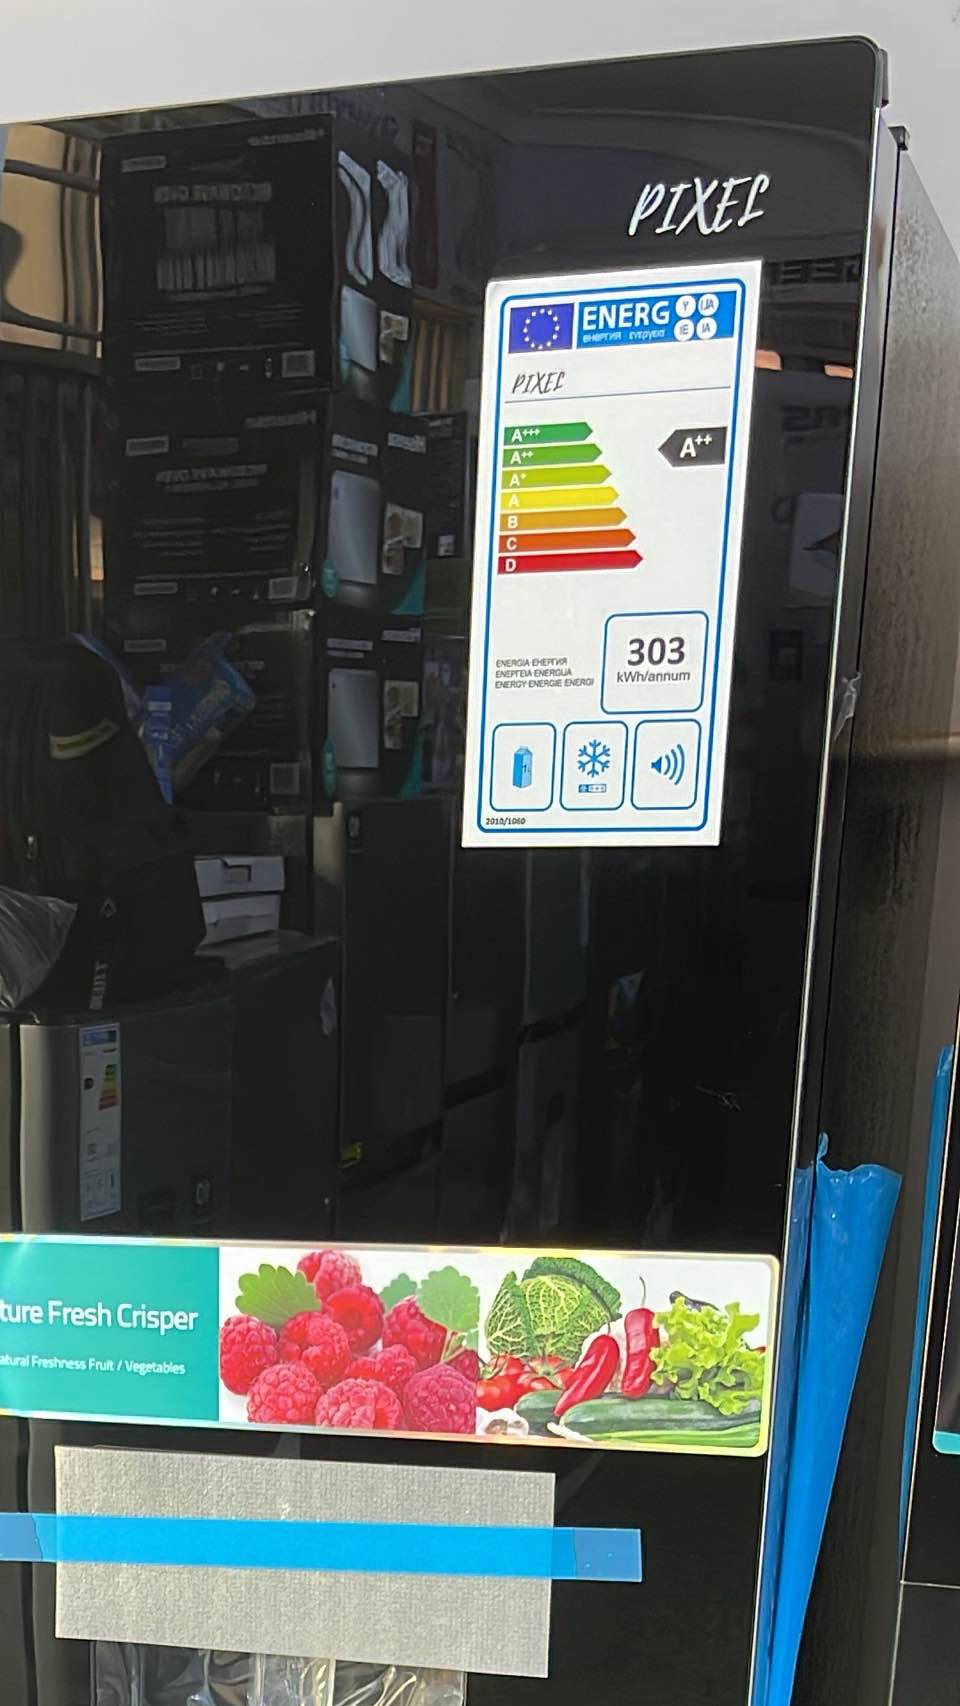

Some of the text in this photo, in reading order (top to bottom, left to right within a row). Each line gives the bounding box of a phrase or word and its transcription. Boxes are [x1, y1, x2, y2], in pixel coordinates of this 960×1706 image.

[628, 174, 770, 236] PIXEL
[583, 301, 670, 330] ENERG
[512, 371, 566, 394] PIXEL
[511, 428, 540, 443] A+++
[679, 433, 713, 458] A++
[510, 450, 534, 465] A++
[509, 472, 527, 487] A+
[509, 494, 520, 508] A
[507, 516, 518, 528] B
[506, 537, 517, 551] C
[505, 558, 517, 572] D
[627, 636, 686, 666] 303
[616, 671, 691, 684] kWh/annum
[48, 1300, 112, 1328] Fresh
[117, 1303, 199, 1336] Crisper
[31, 1354, 86, 1371] Freshness
[89, 1357, 115, 1372] Fruit
[125, 1360, 186, 1376] Vegetables
